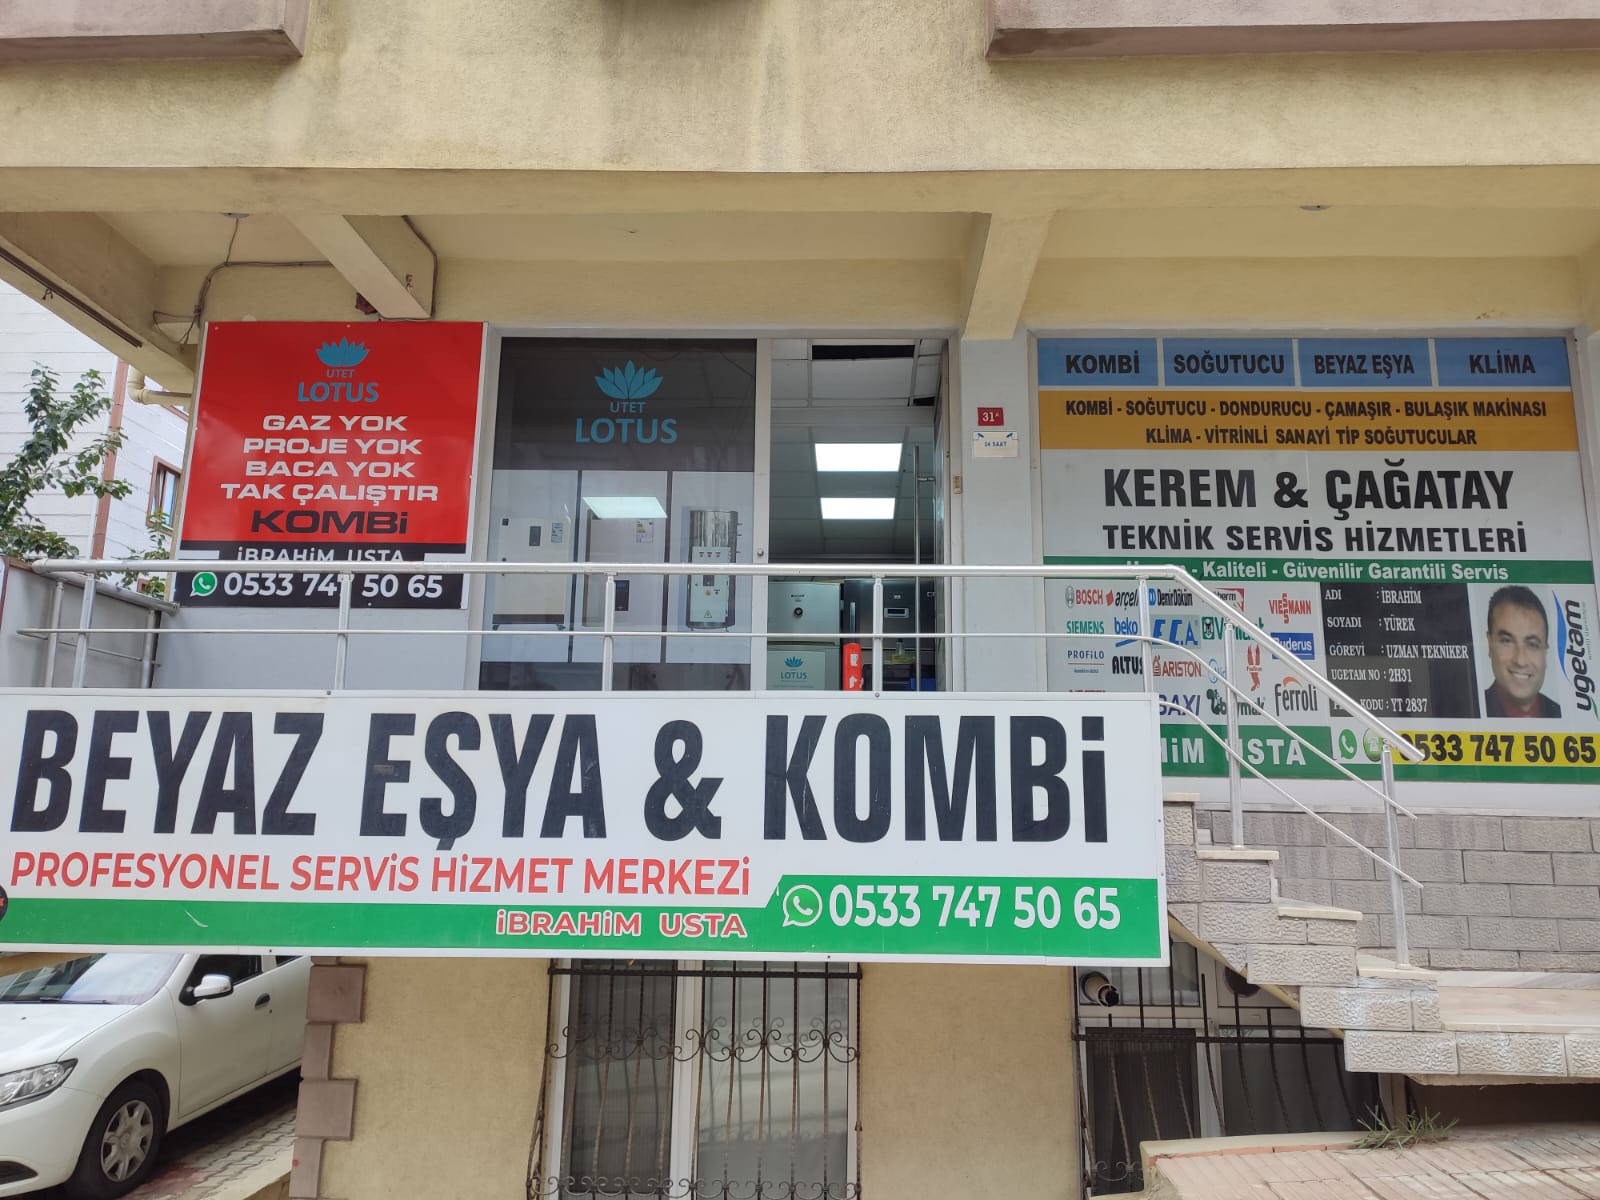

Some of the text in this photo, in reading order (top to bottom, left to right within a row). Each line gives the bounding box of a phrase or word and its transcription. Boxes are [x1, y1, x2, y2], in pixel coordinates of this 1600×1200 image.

[1066, 350, 1140, 374] KOMBİ
[1174, 350, 1284, 374] SOĞUTUCU
[1314, 354, 1415, 379] BEYAZ EŞYA
[1469, 349, 1536, 374] KLİMA
[326, 369, 354, 379] UTET
[297, 382, 379, 402] LOTUS
[610, 402, 646, 414] UTET
[1066, 397, 1113, 416] KOMBİ
[1126, 397, 1207, 416] SOĞUTUCU
[1220, 400, 1311, 416] DONDURUCU
[1325, 401, 1391, 420] ÇAMAŞIR
[1404, 401, 1469, 420] BULAŞIK
[1473, 398, 1547, 417] MAKİNASI
[263, 415, 408, 431] GAZ YOK
[575, 418, 678, 444] LOTUS
[1146, 425, 1192, 444] KLİMA
[1205, 425, 1268, 444] VİTRİNLİ
[1276, 426, 1331, 445] SANAYİ
[1336, 426, 1360, 445] TİP
[1364, 426, 1477, 445] SOĞUTUCULAR
[243, 439, 422, 455] PROJE YOK
[245, 461, 415, 478] BACA YOK
[221, 484, 438, 506] TAK ÇALIŞTIR
[1104, 459, 1514, 521] KEREM & ÇAĞATAY
[1102, 518, 1527, 552] TEKNİK SERVİS HİZMETLERİ
[1203, 562, 1266, 578] Kaliteli
[1283, 562, 1363, 579] Güvenilir
[1368, 563, 1447, 580] Garantili
[1452, 563, 1509, 580] Servis
[224, 573, 293, 596] 0533
[361, 574, 399, 598] 50
[407, 574, 443, 598] 65
[1325, 589, 1341, 600] ADI
[1076, 589, 1103, 605] BOSCH
[1066, 620, 1105, 634] SIEMENS
[1114, 617, 1138, 635] beko
[1327, 617, 1362, 628] SOYADI
[1384, 615, 1416, 631] YÜREK
[1386, 644, 1419, 658] UZMAN
[1565, 600, 1595, 711] ugetam
[781, 672, 807, 680] LOTUS
[1162, 661, 1202, 677] ARISTON
[1331, 669, 1367, 681] UGETAM
[1368, 669, 1380, 681] NO
[1388, 669, 1412, 683] 2H31
[1391, 698, 1404, 712] YT
[1405, 698, 1428, 713] 2837
[1470, 735, 1515, 762] 747
[1524, 735, 1556, 763] 50
[1563, 735, 1596, 763] 65
[10, 709, 325, 836] BEYAZ
[359, 712, 607, 850] EŞYA
[643, 719, 724, 841] &
[10, 852, 279, 891] PROFESYONEL
[829, 885, 1121, 931] 0533 747 50 65
[659, 912, 748, 938] USTA
